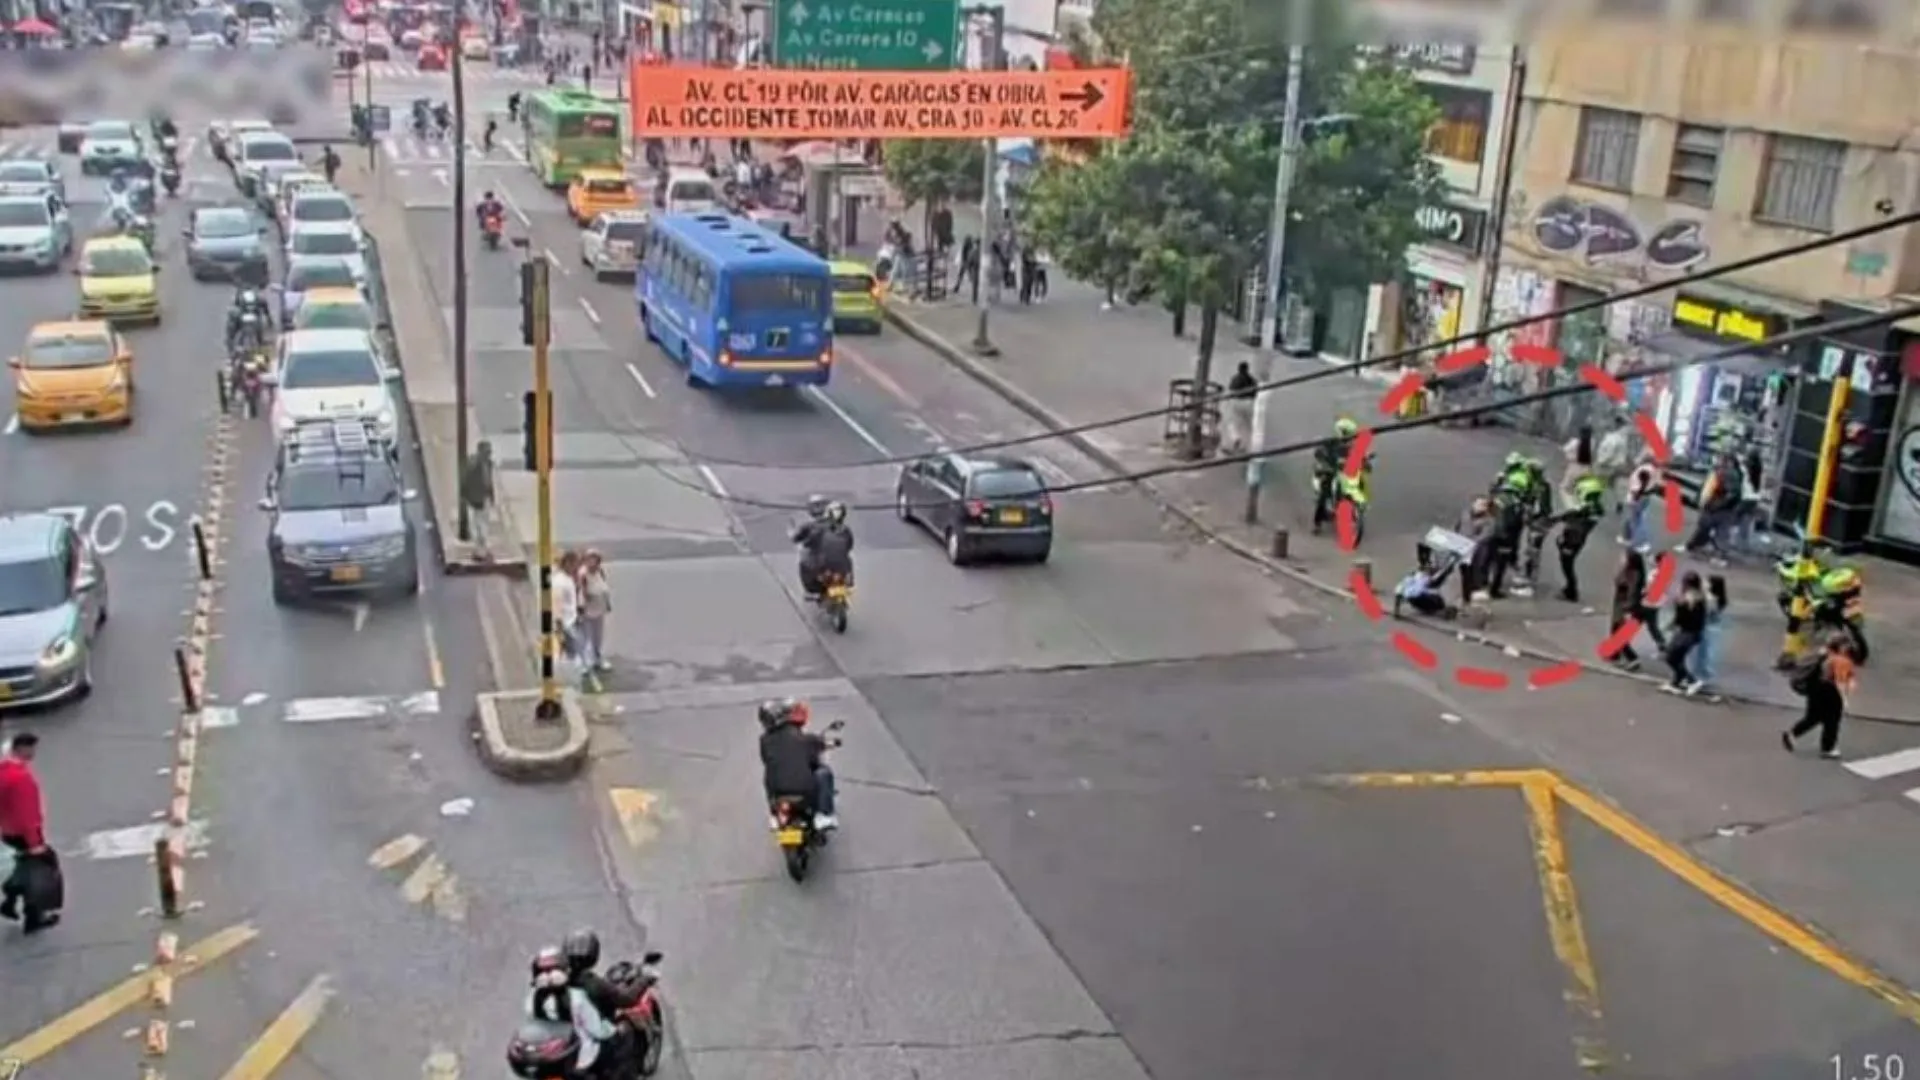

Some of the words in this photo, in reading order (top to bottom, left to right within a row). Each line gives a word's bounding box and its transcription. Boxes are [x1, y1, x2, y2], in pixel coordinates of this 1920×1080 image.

[816, 4, 846, 23] Av
[849, 3, 926, 24] Caracas
[785, 28, 814, 47] Av
[818, 28, 891, 48] Carrera
[895, 29, 918, 47] 10
[685, 79, 717, 103] AV.
[723, 81, 750, 103] CL
[758, 83, 780, 103] 19
[786, 83, 828, 104] POR
[834, 83, 864, 104] AV.
[870, 82, 960, 104] CARACAS
[967, 83, 991, 104] EN
[998, 83, 1047, 104] OBRA
[646, 106, 673, 127] AL
[681, 107, 800, 128] OCCIDENTE
[807, 108, 876, 128] TOMAR
[917, 109, 959, 128] CRA
[963, 110, 983, 128] 10
[1000, 109, 1026, 128] AV.
[1032, 109, 1054, 128] CL
[1057, 110, 1078, 129] 26
